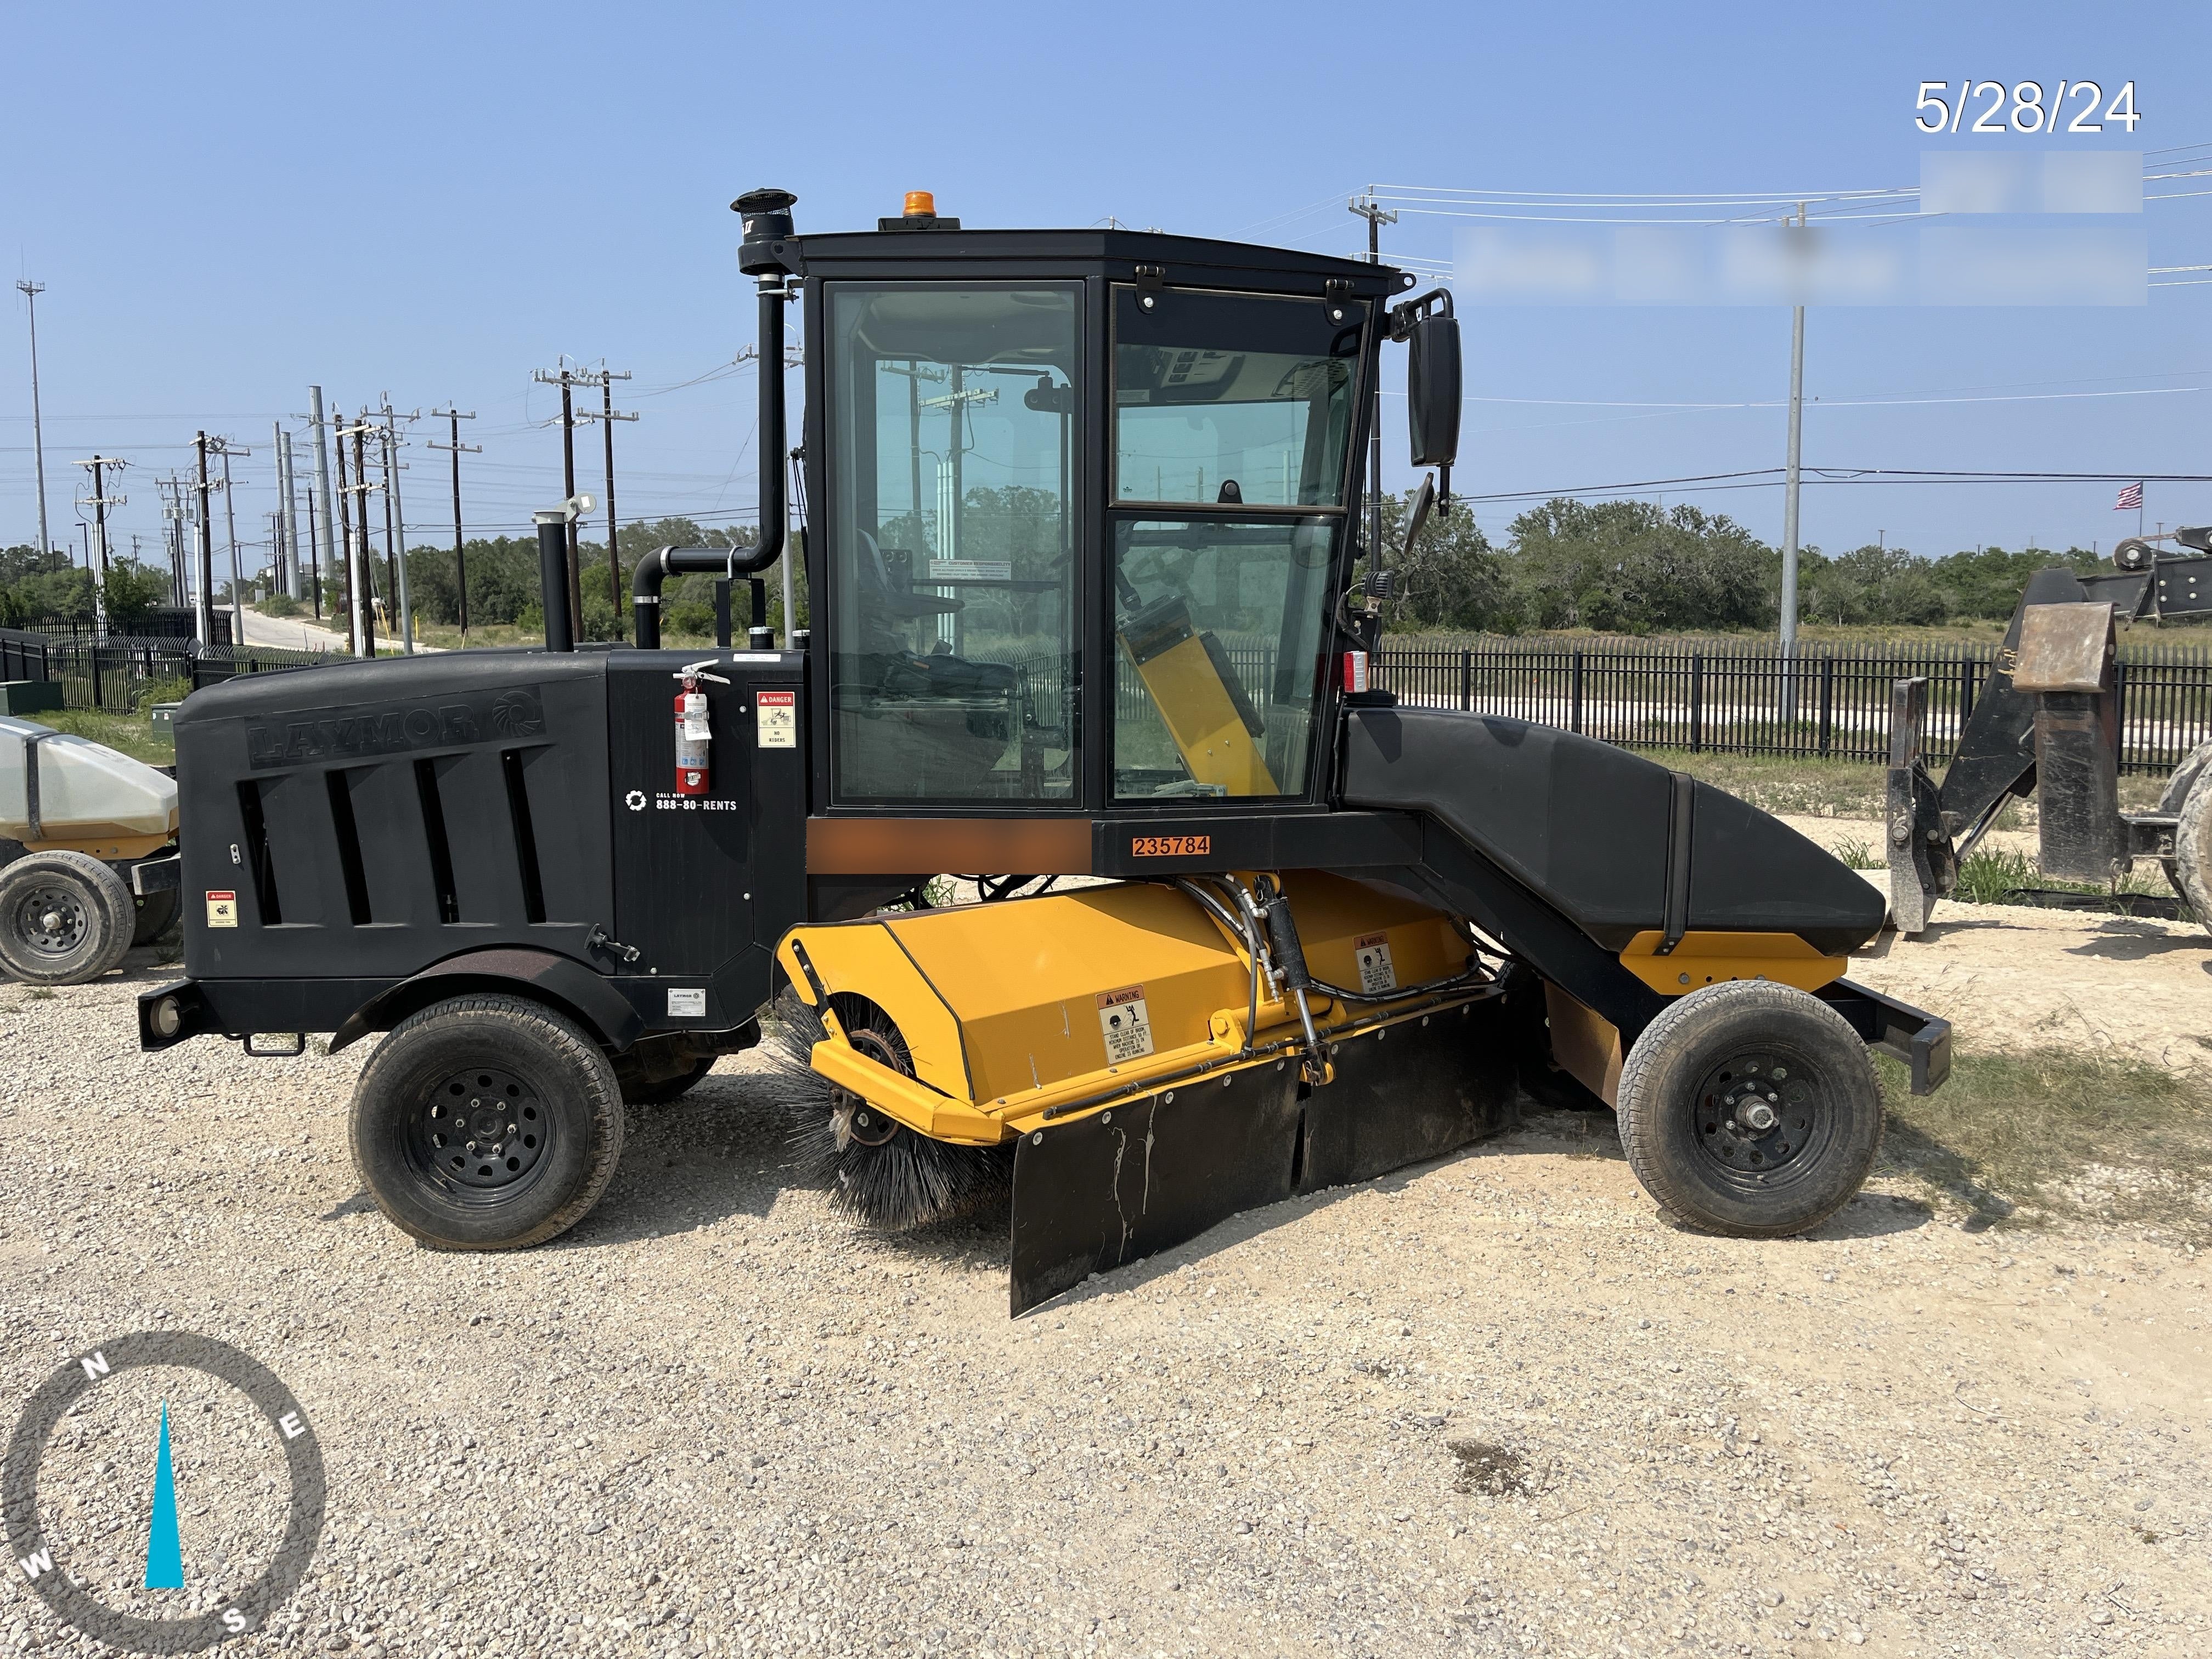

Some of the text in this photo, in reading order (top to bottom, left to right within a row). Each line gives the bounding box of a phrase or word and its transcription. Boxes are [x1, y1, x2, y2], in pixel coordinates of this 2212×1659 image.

[248, 704, 480, 761] LAYMOR
[656, 799, 737, 810] 888-80-RENTS
[1135, 837, 1208, 855] 235784
[1115, 990, 1139, 1003] WARNING
